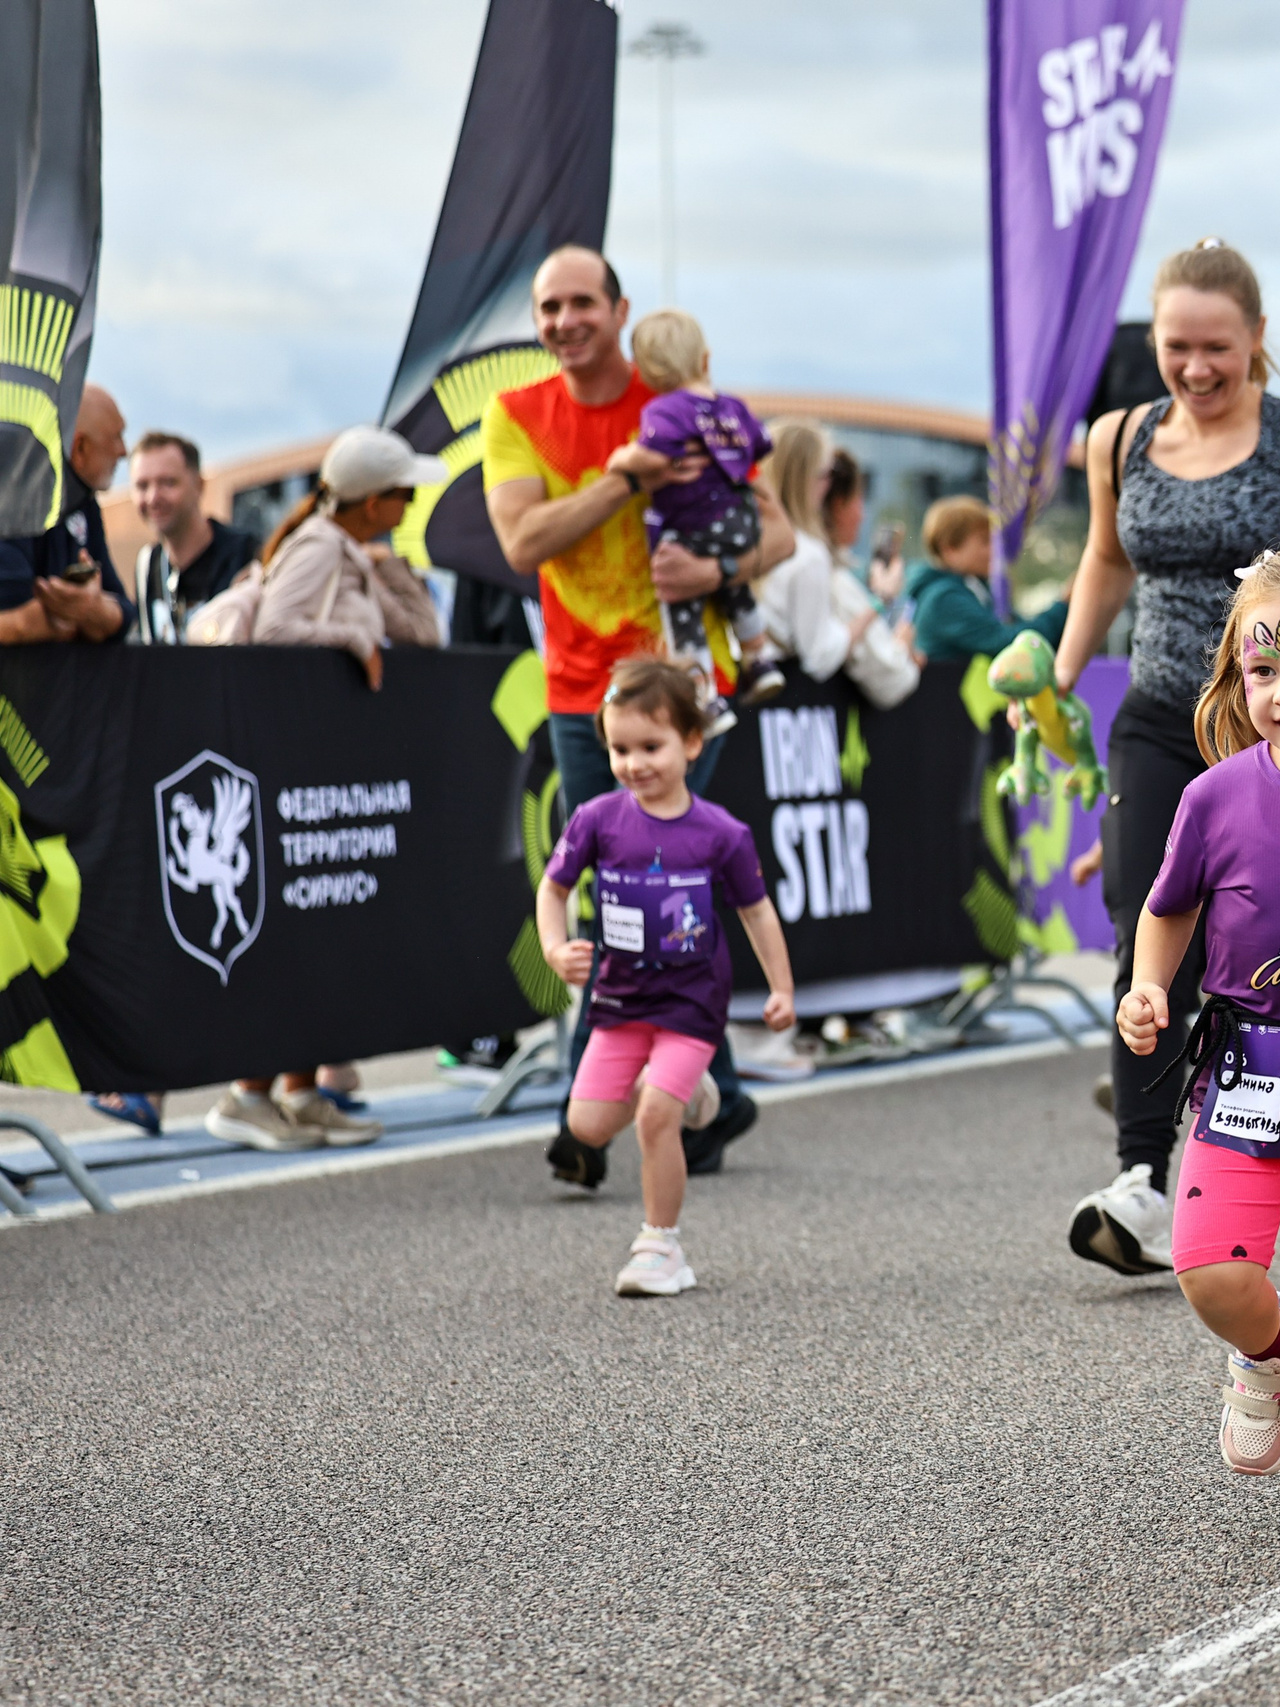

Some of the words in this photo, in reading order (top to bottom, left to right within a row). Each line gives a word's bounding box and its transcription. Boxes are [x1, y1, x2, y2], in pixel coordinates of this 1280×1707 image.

[276, 779, 411, 824] ФЕДЕРАЛЬНАЯ
[279, 823, 397, 867] ТЕРРИТОРИЯ
[771, 799, 872, 924] STAR
[282, 869, 379, 910] «СИРИУС»
